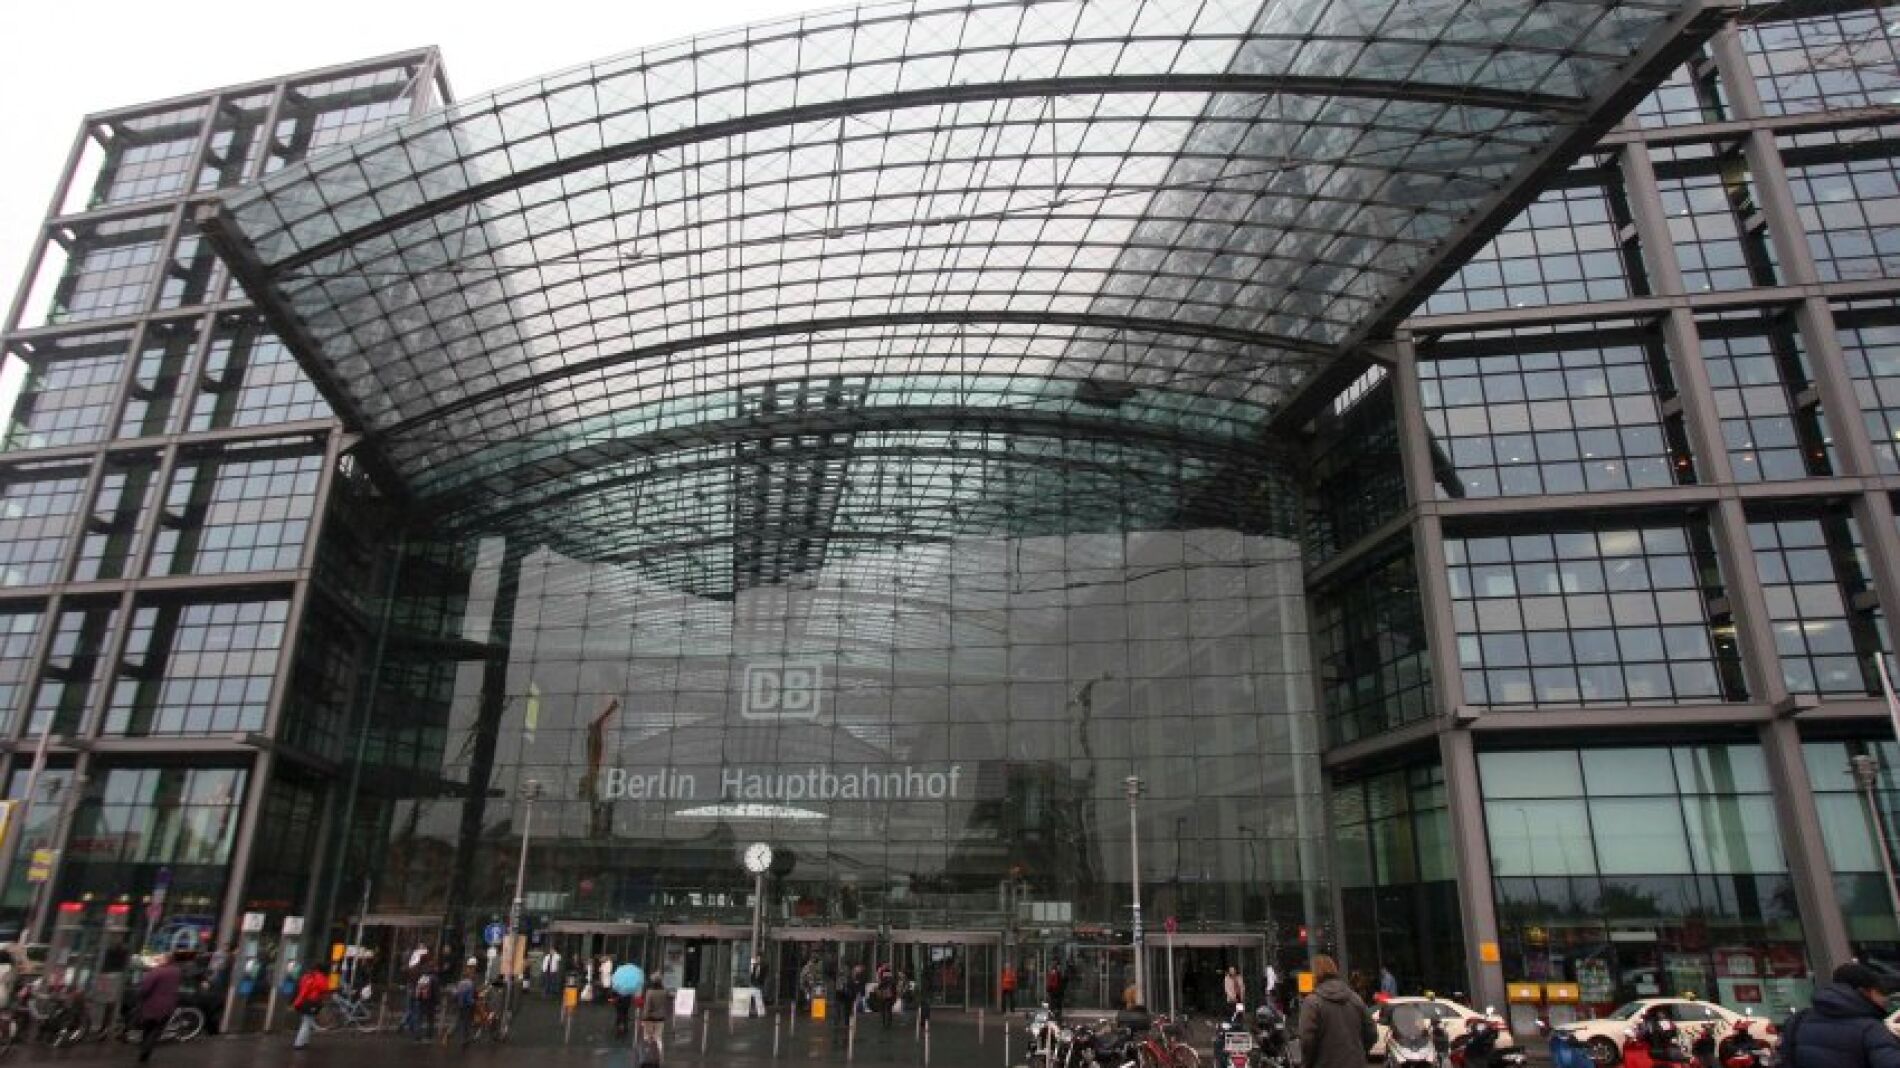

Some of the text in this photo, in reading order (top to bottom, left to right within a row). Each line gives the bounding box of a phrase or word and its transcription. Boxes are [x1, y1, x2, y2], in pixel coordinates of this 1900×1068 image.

[750, 669, 812, 709] DB
[605, 765, 961, 805] Berlin Hauptbahnhof
